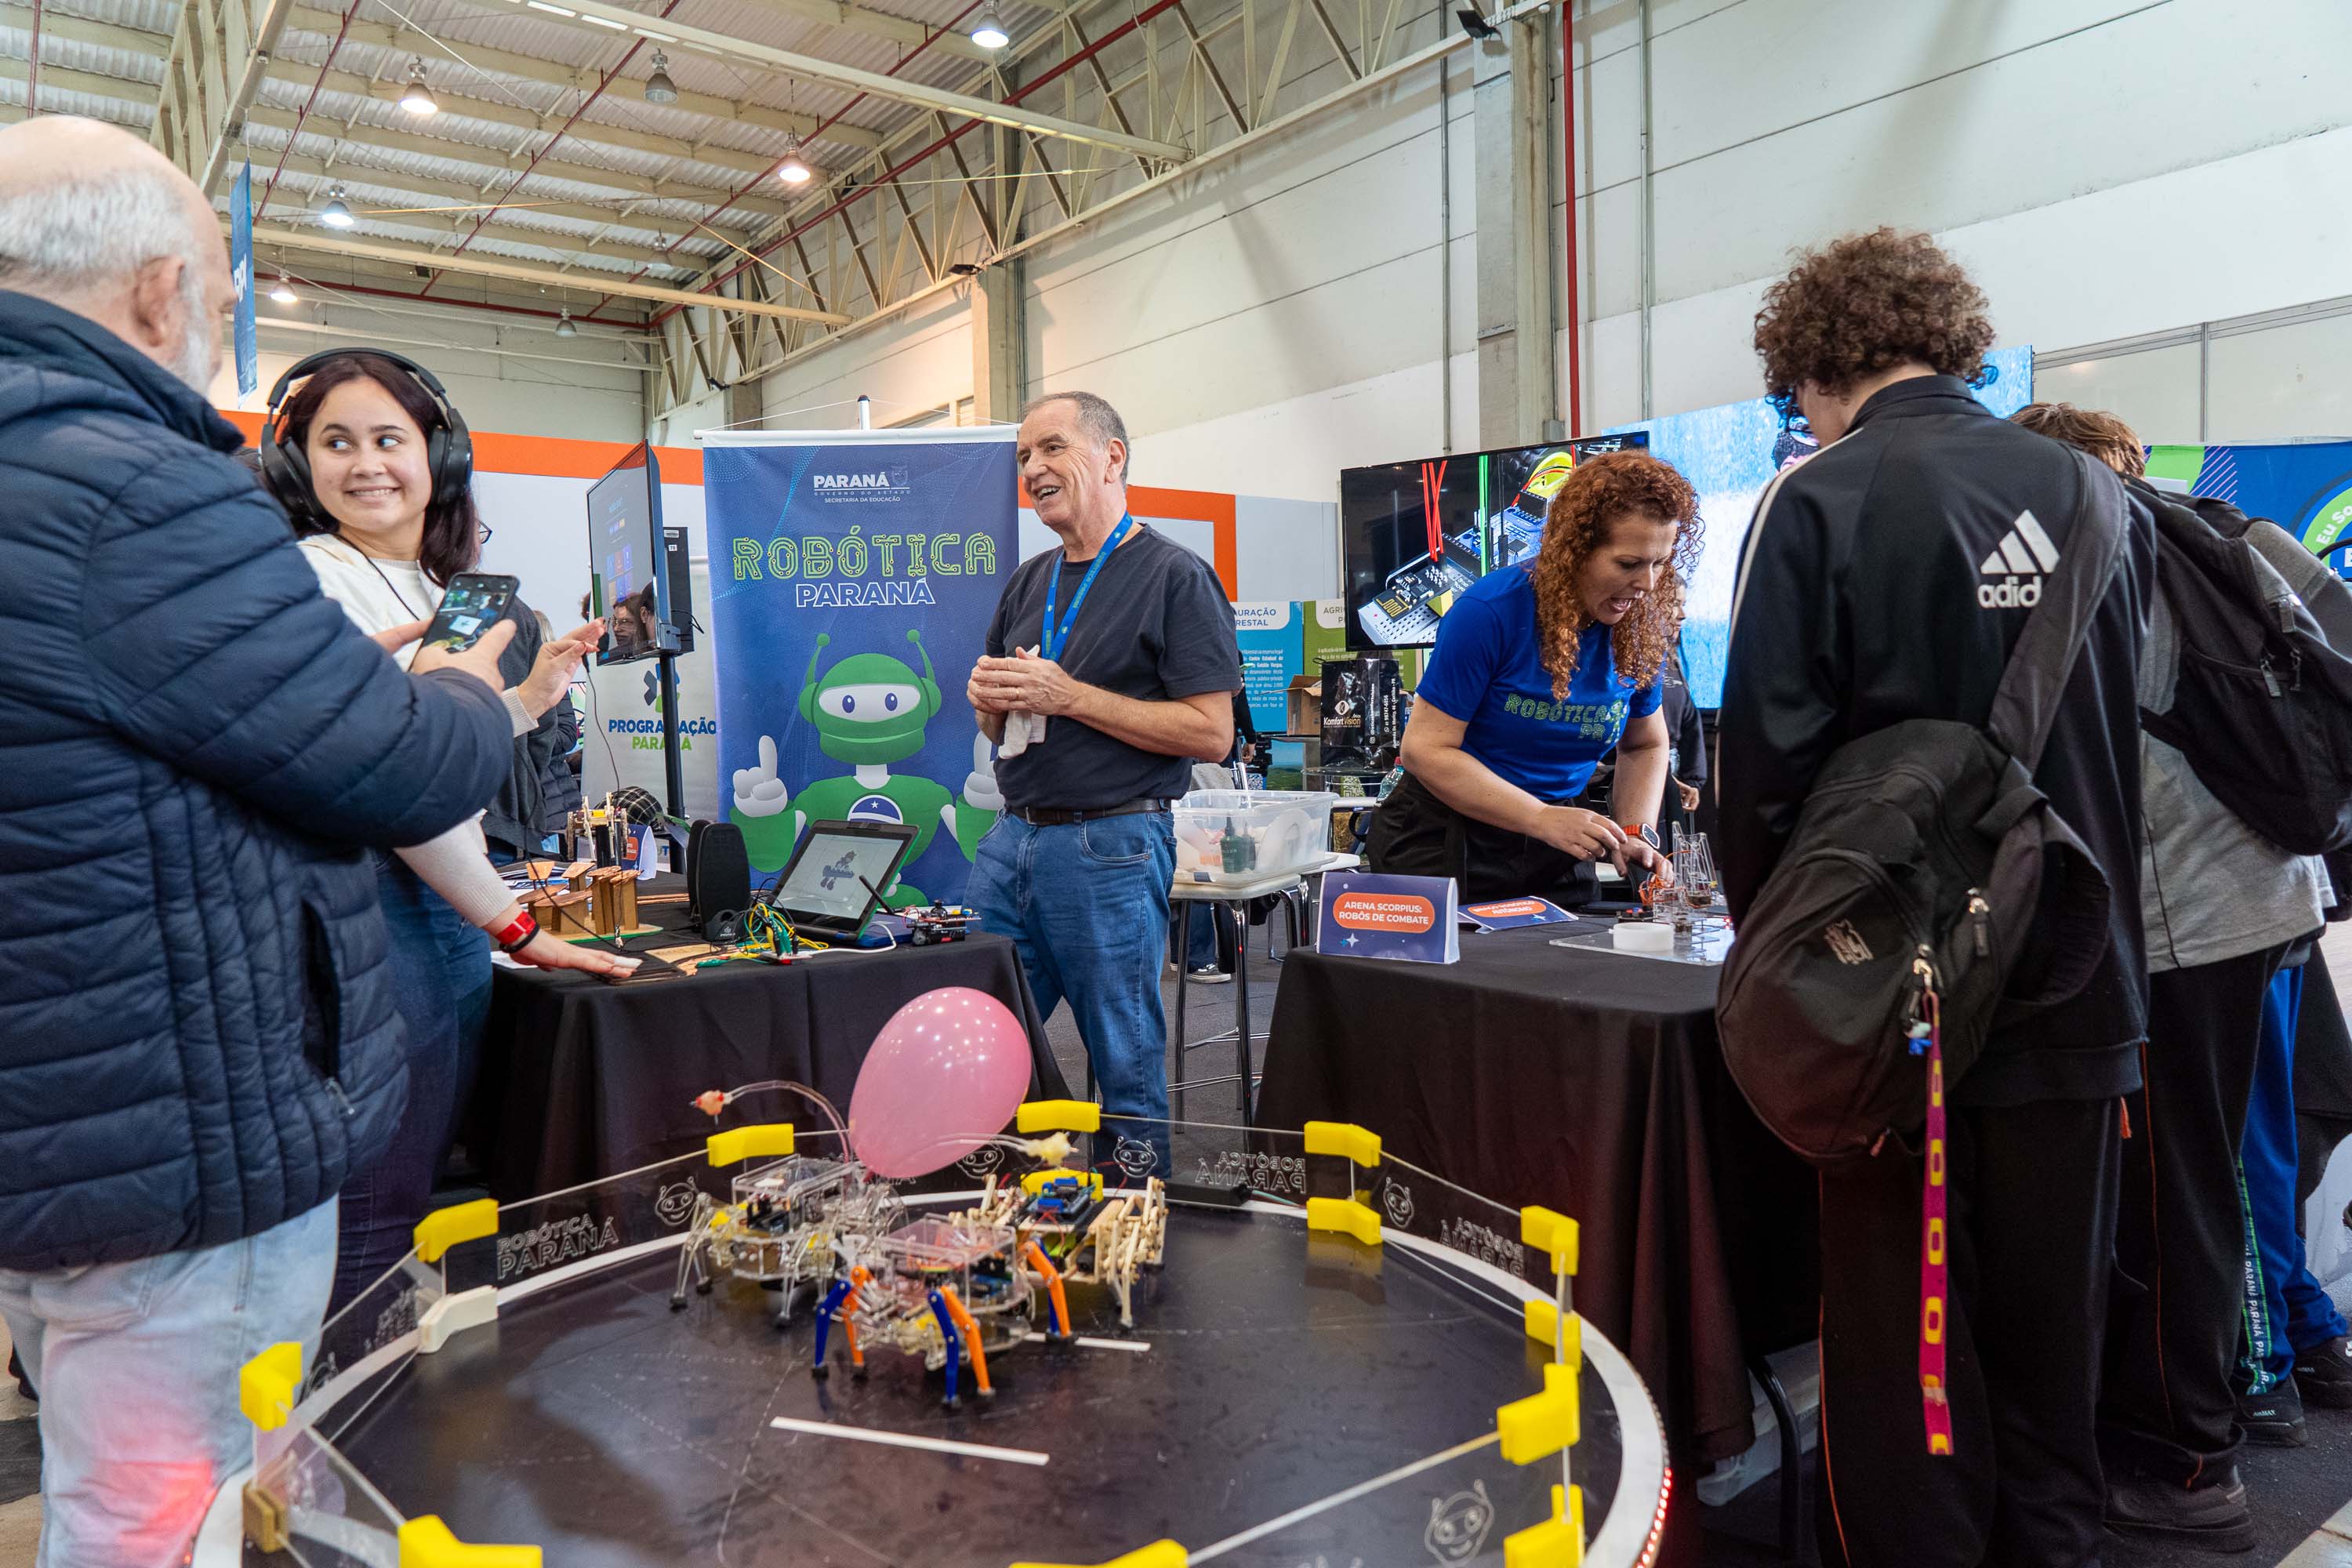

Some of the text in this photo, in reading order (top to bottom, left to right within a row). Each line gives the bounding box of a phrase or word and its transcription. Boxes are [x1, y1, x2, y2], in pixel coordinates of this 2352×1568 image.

[813, 471, 890, 488] PARANÁ
[2315, 524, 2337, 545] Eu
[732, 525, 996, 580] ROBÓTICA
[796, 576, 936, 608] PARANÁ
[1236, 607, 1276, 617] URAÇÃO
[1504, 693, 1608, 723] ROBÓTICA
[608, 717, 717, 736] PROGRAAÇÃO
[1578, 724, 1606, 740] PR
[1338, 911, 1370, 920] ROBÔS
[1386, 914, 1428, 924] COMBATE
[1344, 902, 1422, 913] ARENA SCORPIUS:
[497, 1213, 593, 1254] ROBÓTICA
[497, 1216, 619, 1279] PARANÁ
[2249, 1300, 2264, 1337] PARANÁ
